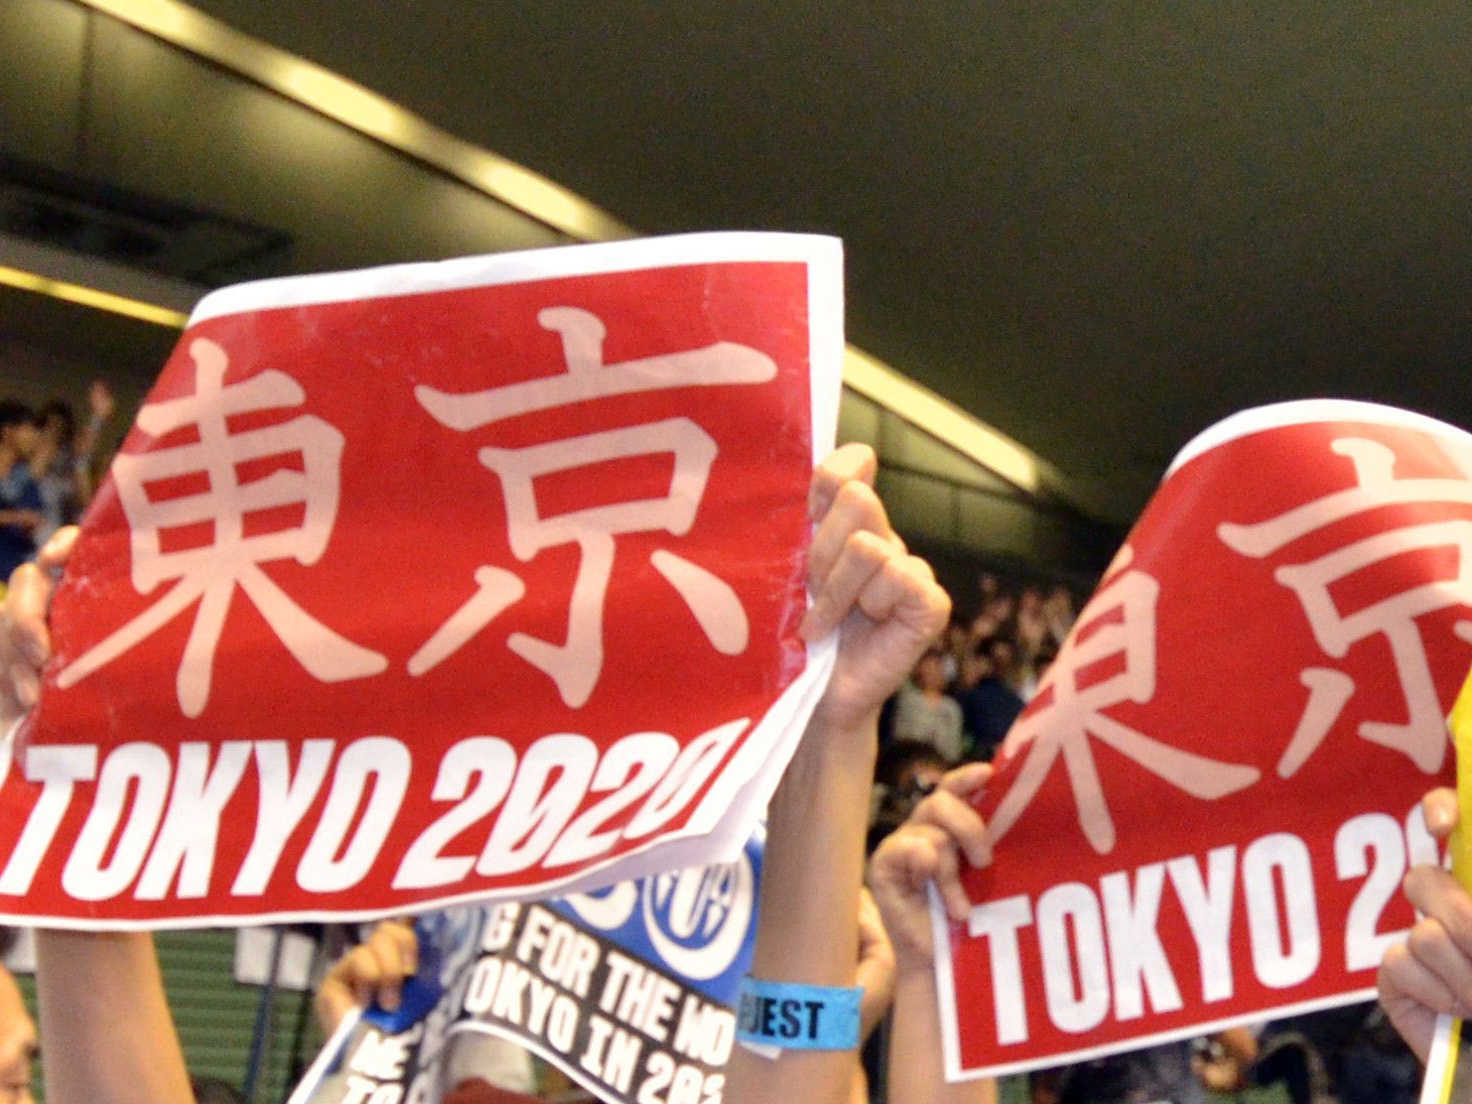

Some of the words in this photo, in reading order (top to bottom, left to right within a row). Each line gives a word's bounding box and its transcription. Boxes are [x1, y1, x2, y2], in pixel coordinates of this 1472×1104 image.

[57, 306, 778, 719] 東京
[0, 735, 412, 900] TOKYO
[391, 717, 751, 890] 2020
[515, 905, 600, 999] FOR
[596, 949, 681, 1043] THE
[968, 832, 1322, 1047] TOKYO
[580, 1017, 641, 1094] IN
